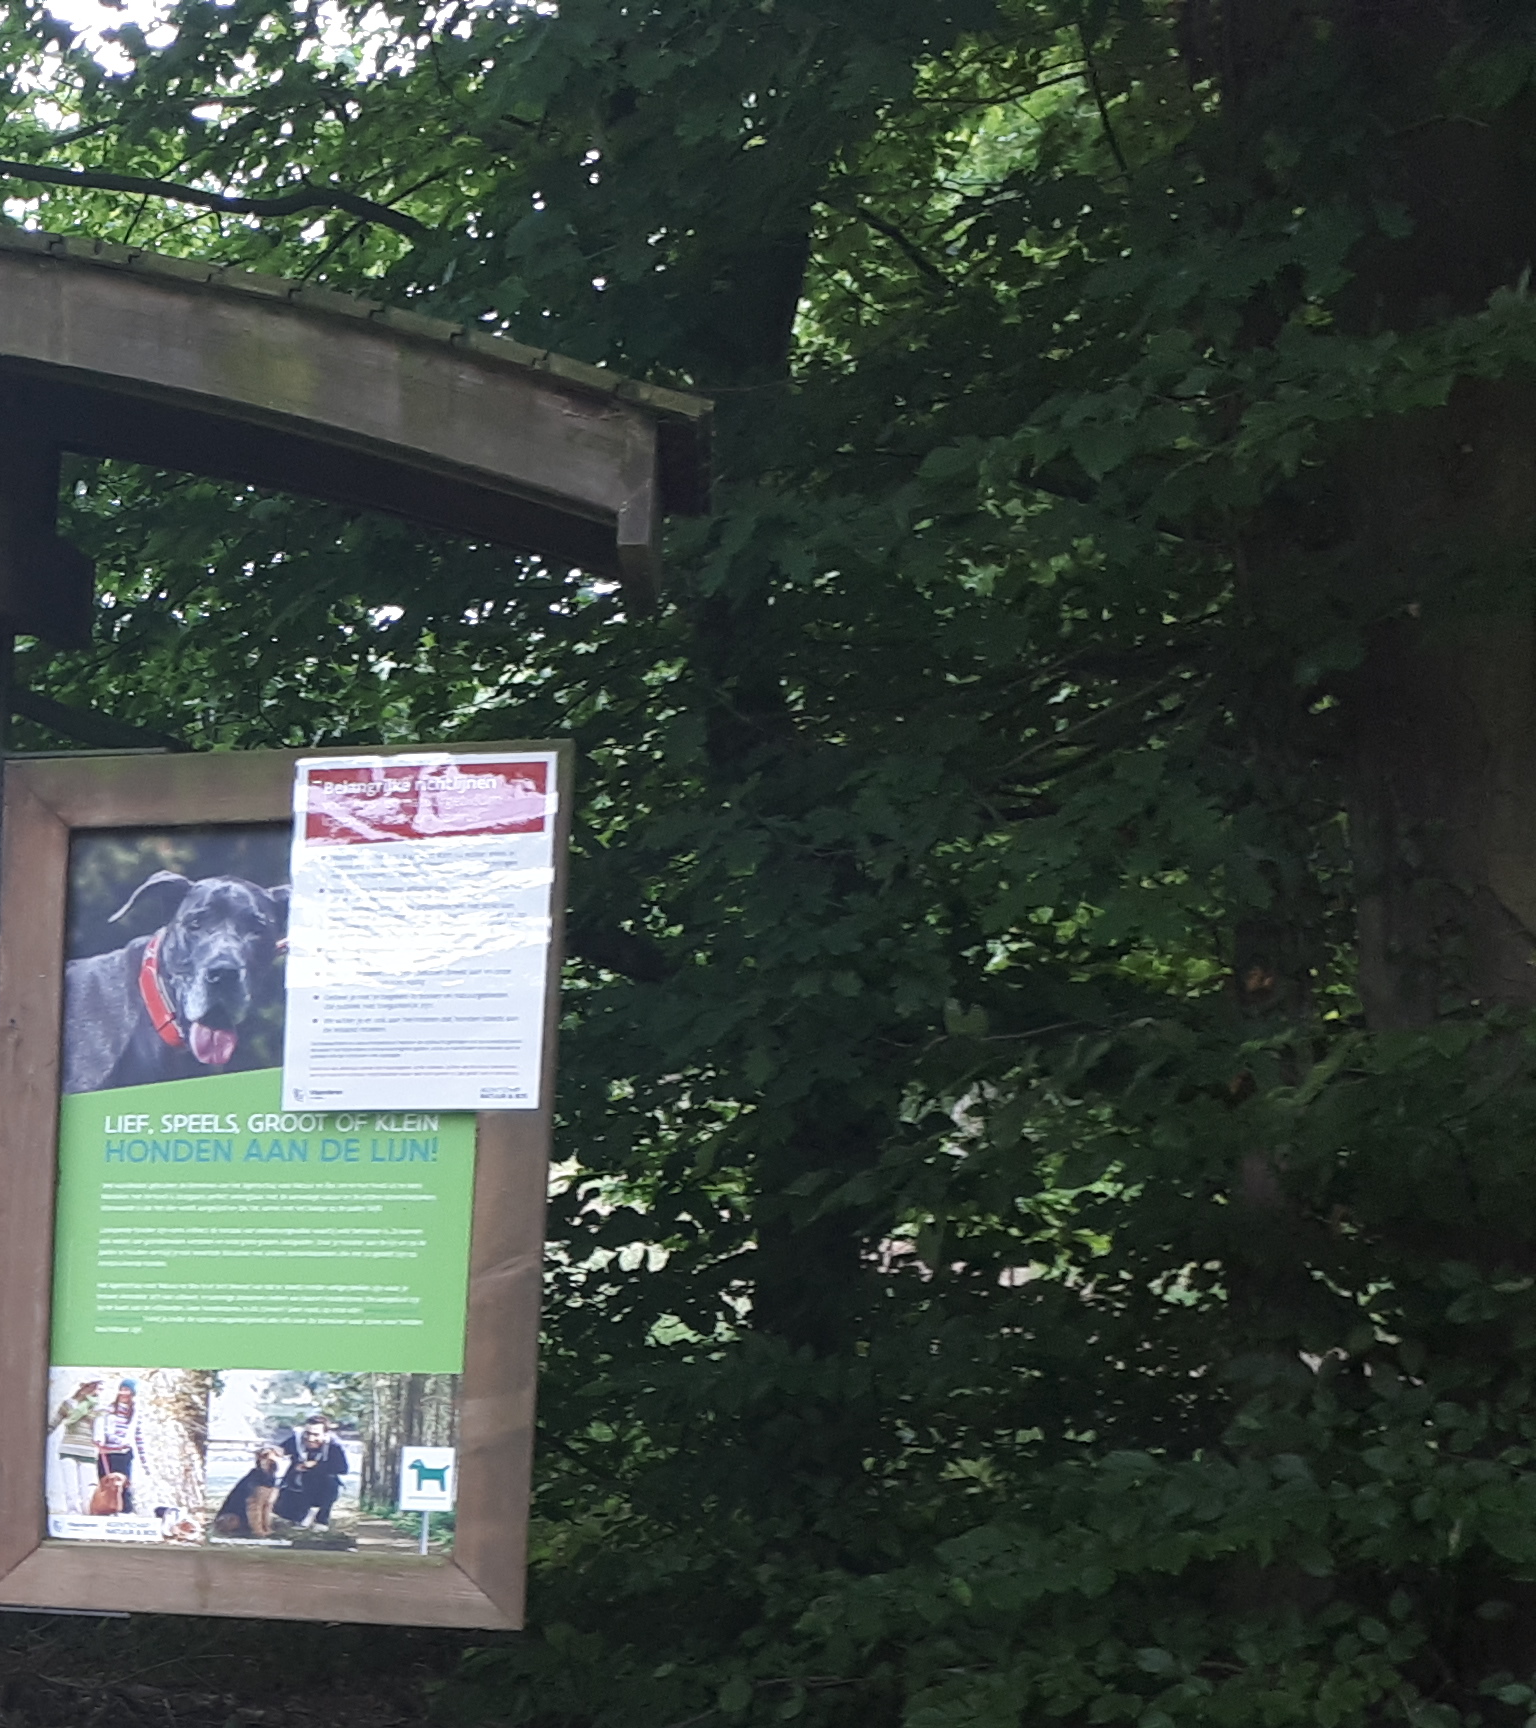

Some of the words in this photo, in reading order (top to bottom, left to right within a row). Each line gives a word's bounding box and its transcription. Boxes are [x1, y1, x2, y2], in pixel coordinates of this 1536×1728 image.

[323, 777, 410, 797] Belangrijke
[415, 775, 496, 794] richtlijnen
[104, 1114, 154, 1135] LIEF,
[159, 1113, 240, 1135] SPEELS,
[247, 1113, 327, 1133] GROOT
[335, 1113, 368, 1133] OF
[375, 1113, 439, 1132] KLEIN
[104, 1139, 232, 1163] HONDEN
[242, 1138, 308, 1163] AAN
[320, 1138, 360, 1162] DE
[370, 1137, 439, 1163] LIJN!
